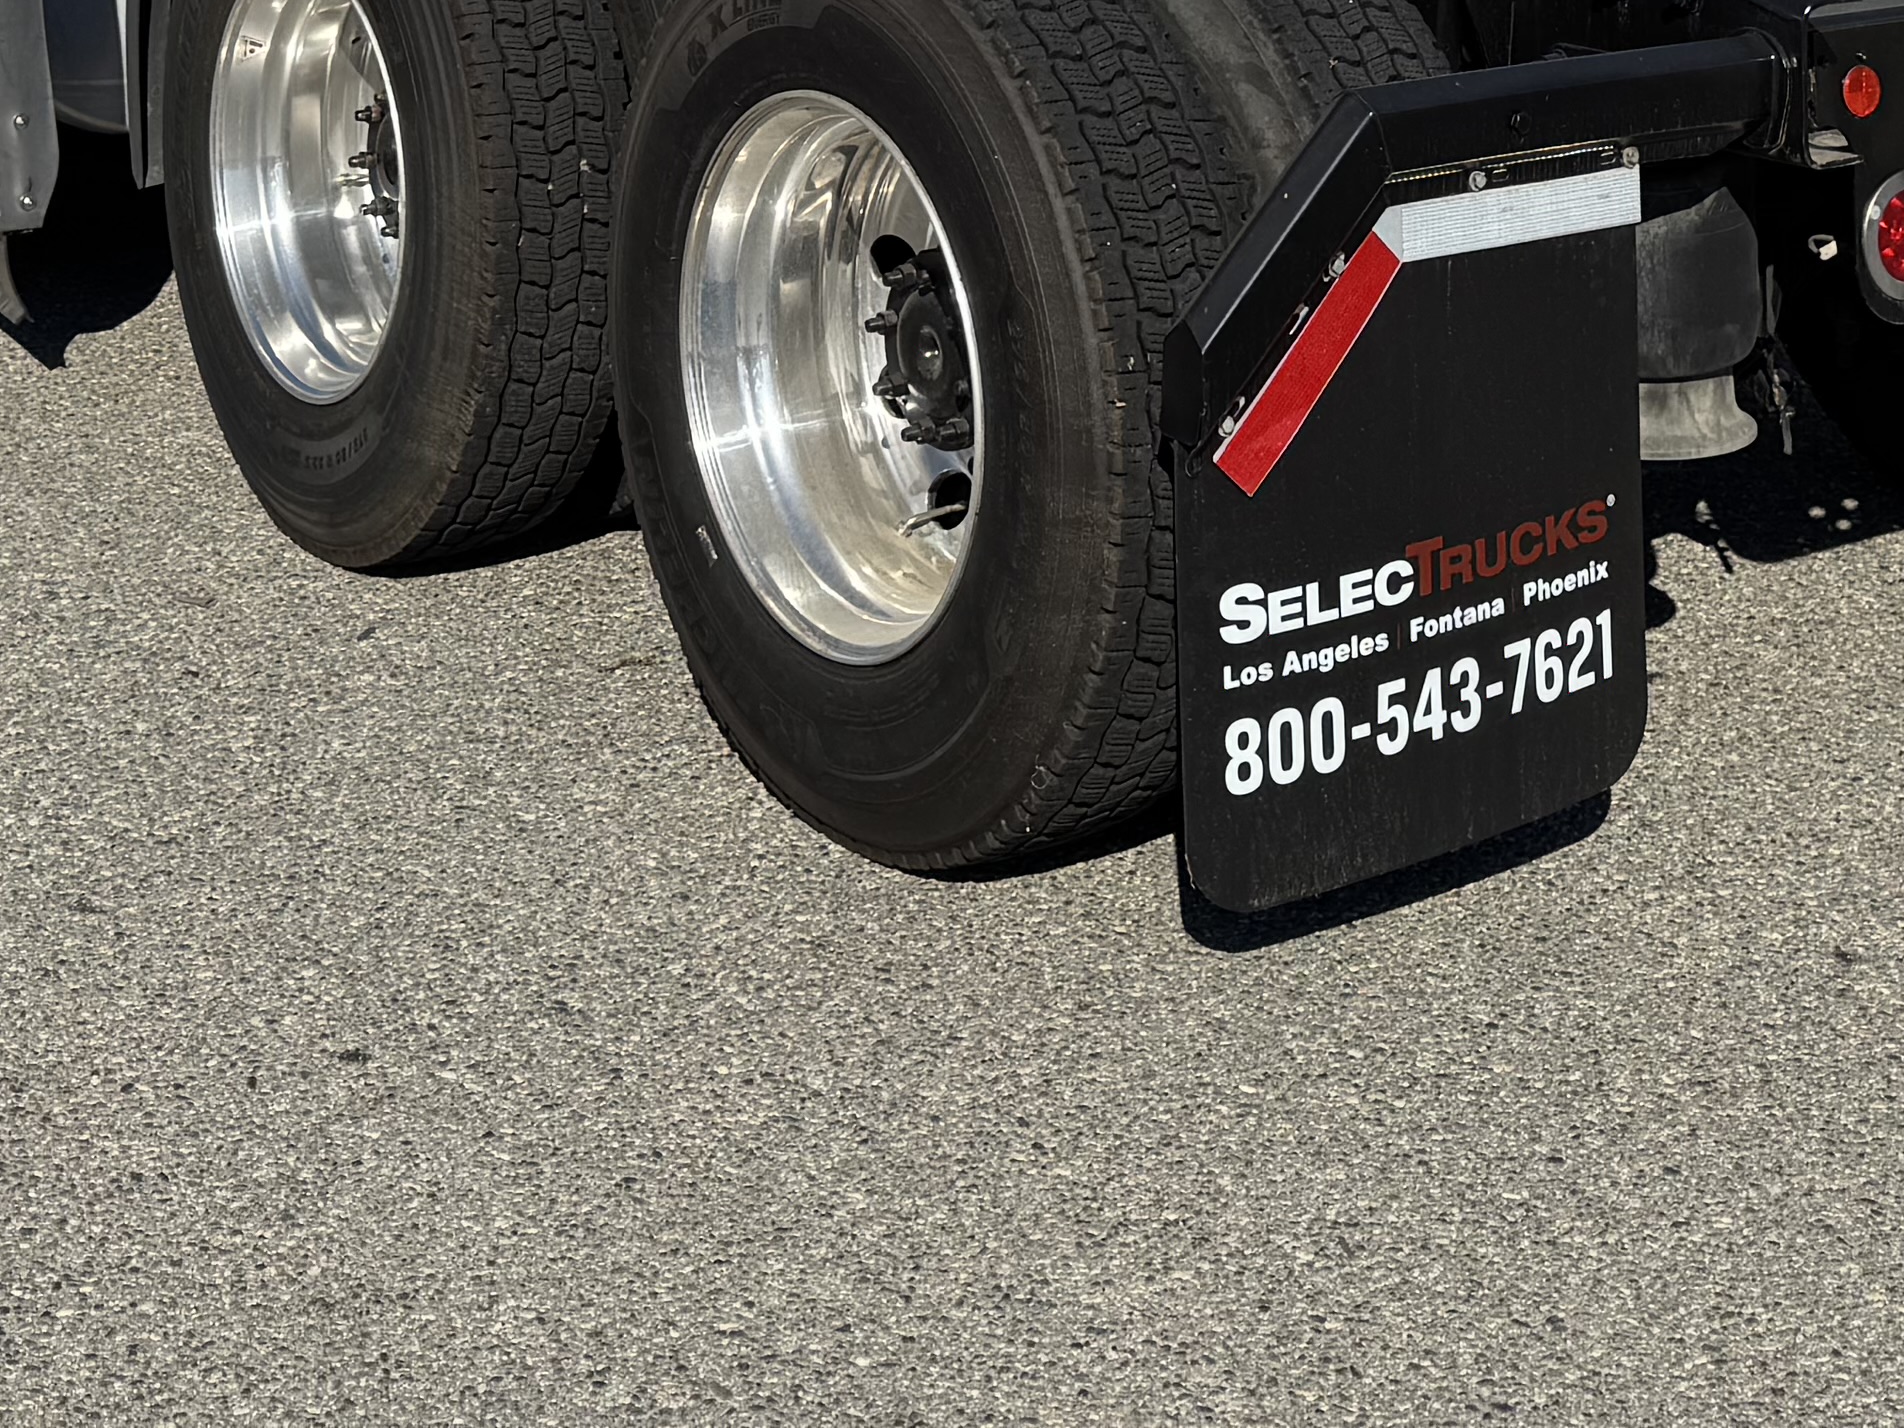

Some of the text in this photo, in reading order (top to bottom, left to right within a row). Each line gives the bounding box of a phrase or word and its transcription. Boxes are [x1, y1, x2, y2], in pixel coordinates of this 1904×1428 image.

[1222, 558, 1611, 691] Los Angeles Fontana Phoenix
[1223, 608, 1614, 797] 800-543-7621
